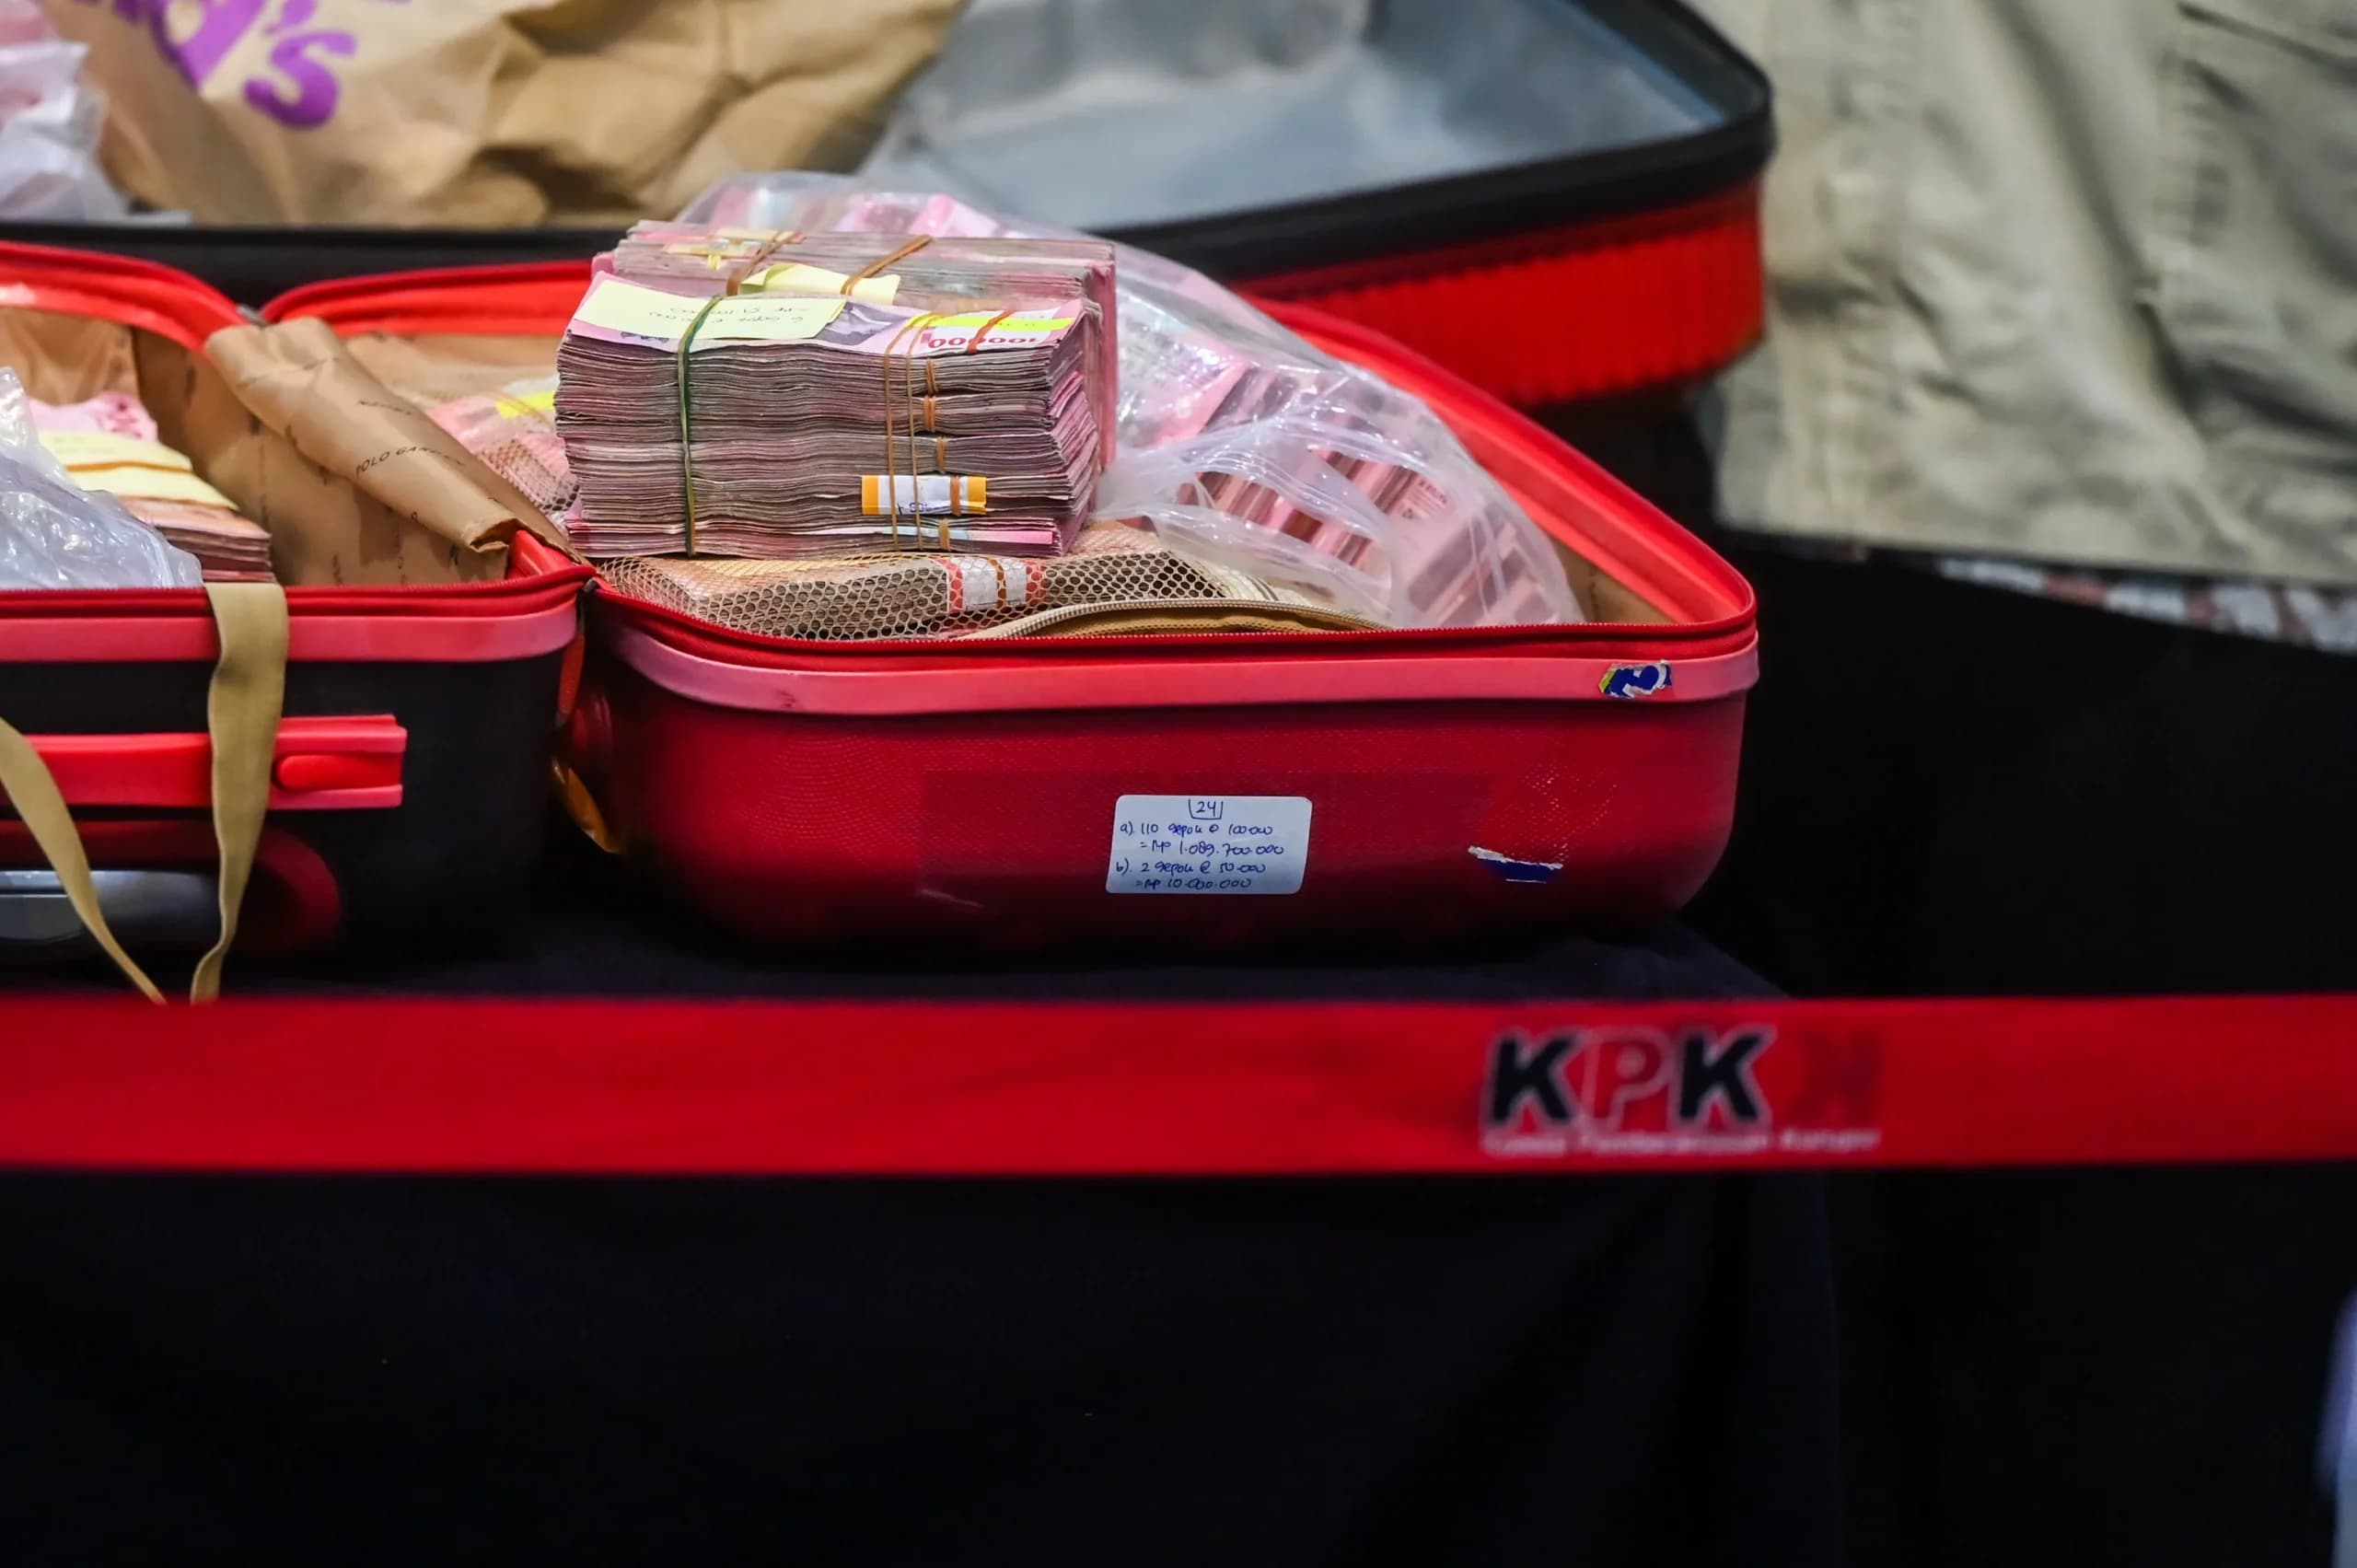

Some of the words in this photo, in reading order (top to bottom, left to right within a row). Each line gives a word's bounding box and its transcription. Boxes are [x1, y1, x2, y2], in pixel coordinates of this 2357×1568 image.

[1196, 800, 1216, 818] 24
[1141, 822, 1159, 835] 110
[1141, 862, 1150, 873] 2
[1485, 1028, 1772, 1130] KPK
